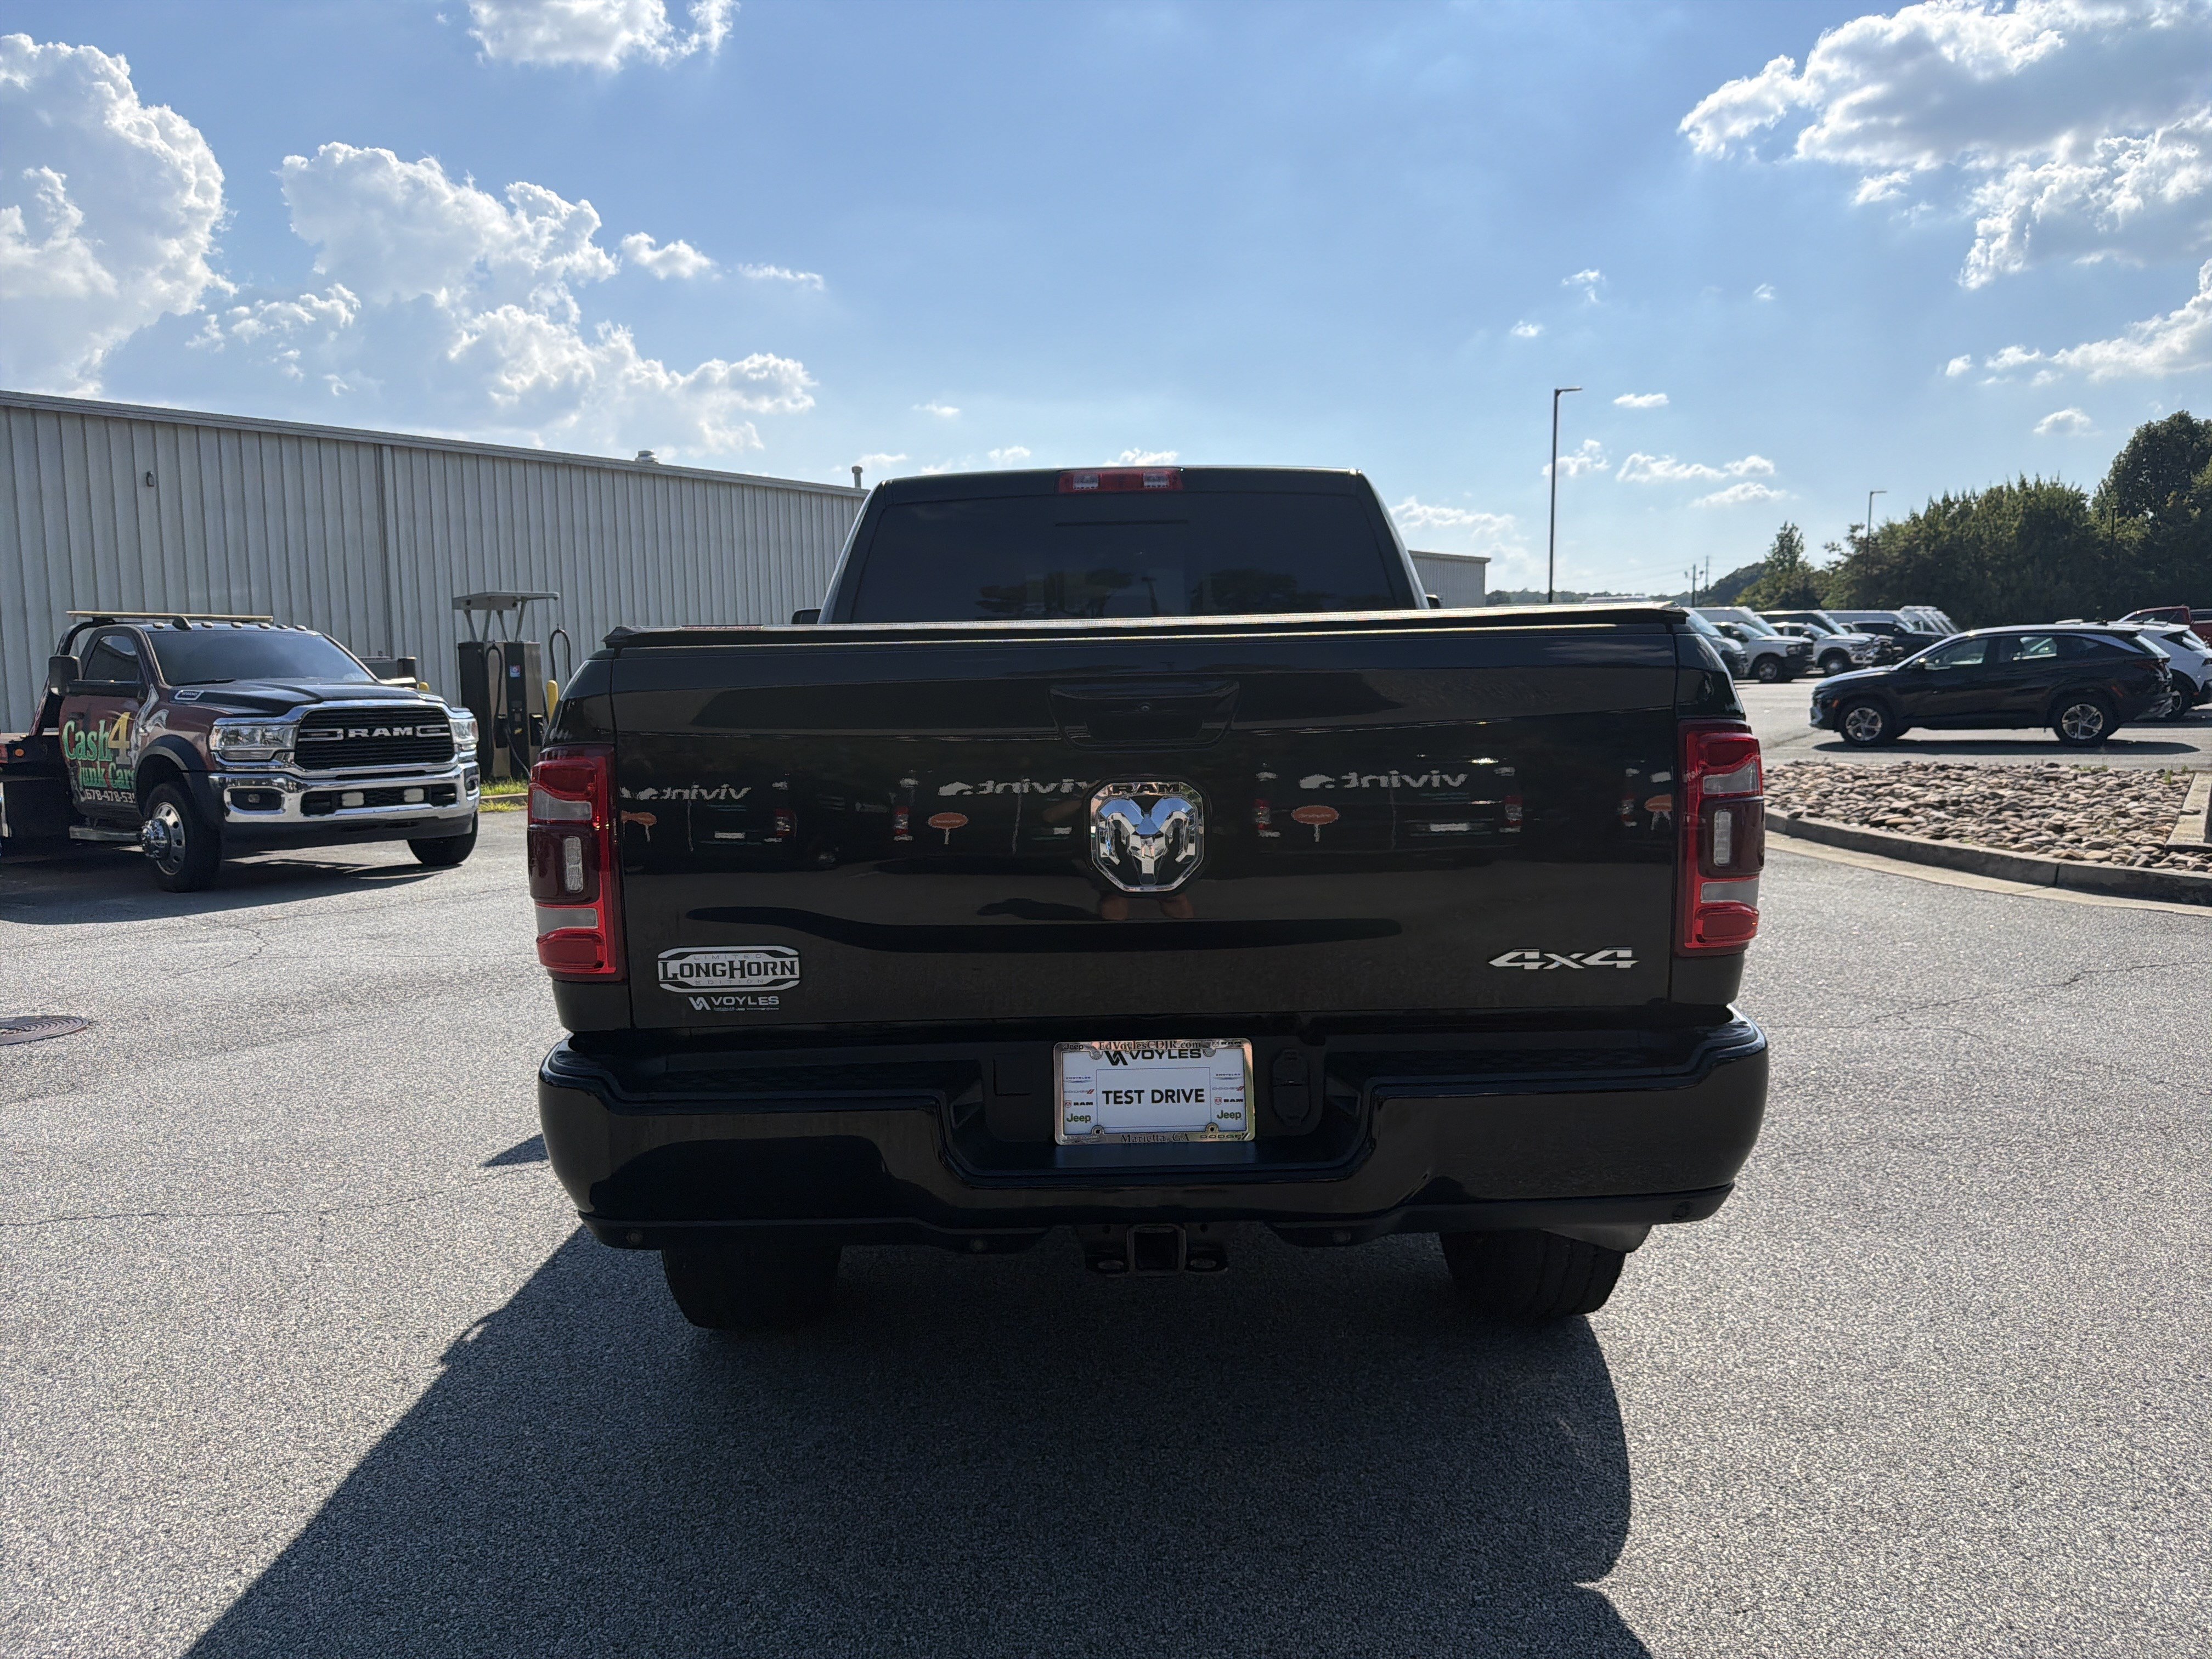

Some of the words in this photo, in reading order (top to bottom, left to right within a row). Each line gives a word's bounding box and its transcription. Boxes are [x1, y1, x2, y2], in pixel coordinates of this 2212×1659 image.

[348, 727, 413, 738] RAM
[62, 719, 112, 761] Cash
[108, 712, 131, 765] 4
[77, 760, 108, 791] Junk
[1112, 782, 1181, 794] RAM
[710, 996, 780, 1006] VOYLES
[1064, 1043, 1084, 1051] Jeep
[1099, 1040, 1201, 1053] EdVoylesCDJR.com
[1129, 1049, 1202, 1060] VOYLES
[1102, 1089, 1145, 1105] TEST
[1151, 1088, 1205, 1104] DRIVE
[1066, 1113, 1091, 1124] Jeep
[1217, 1109, 1242, 1120] Jeep
